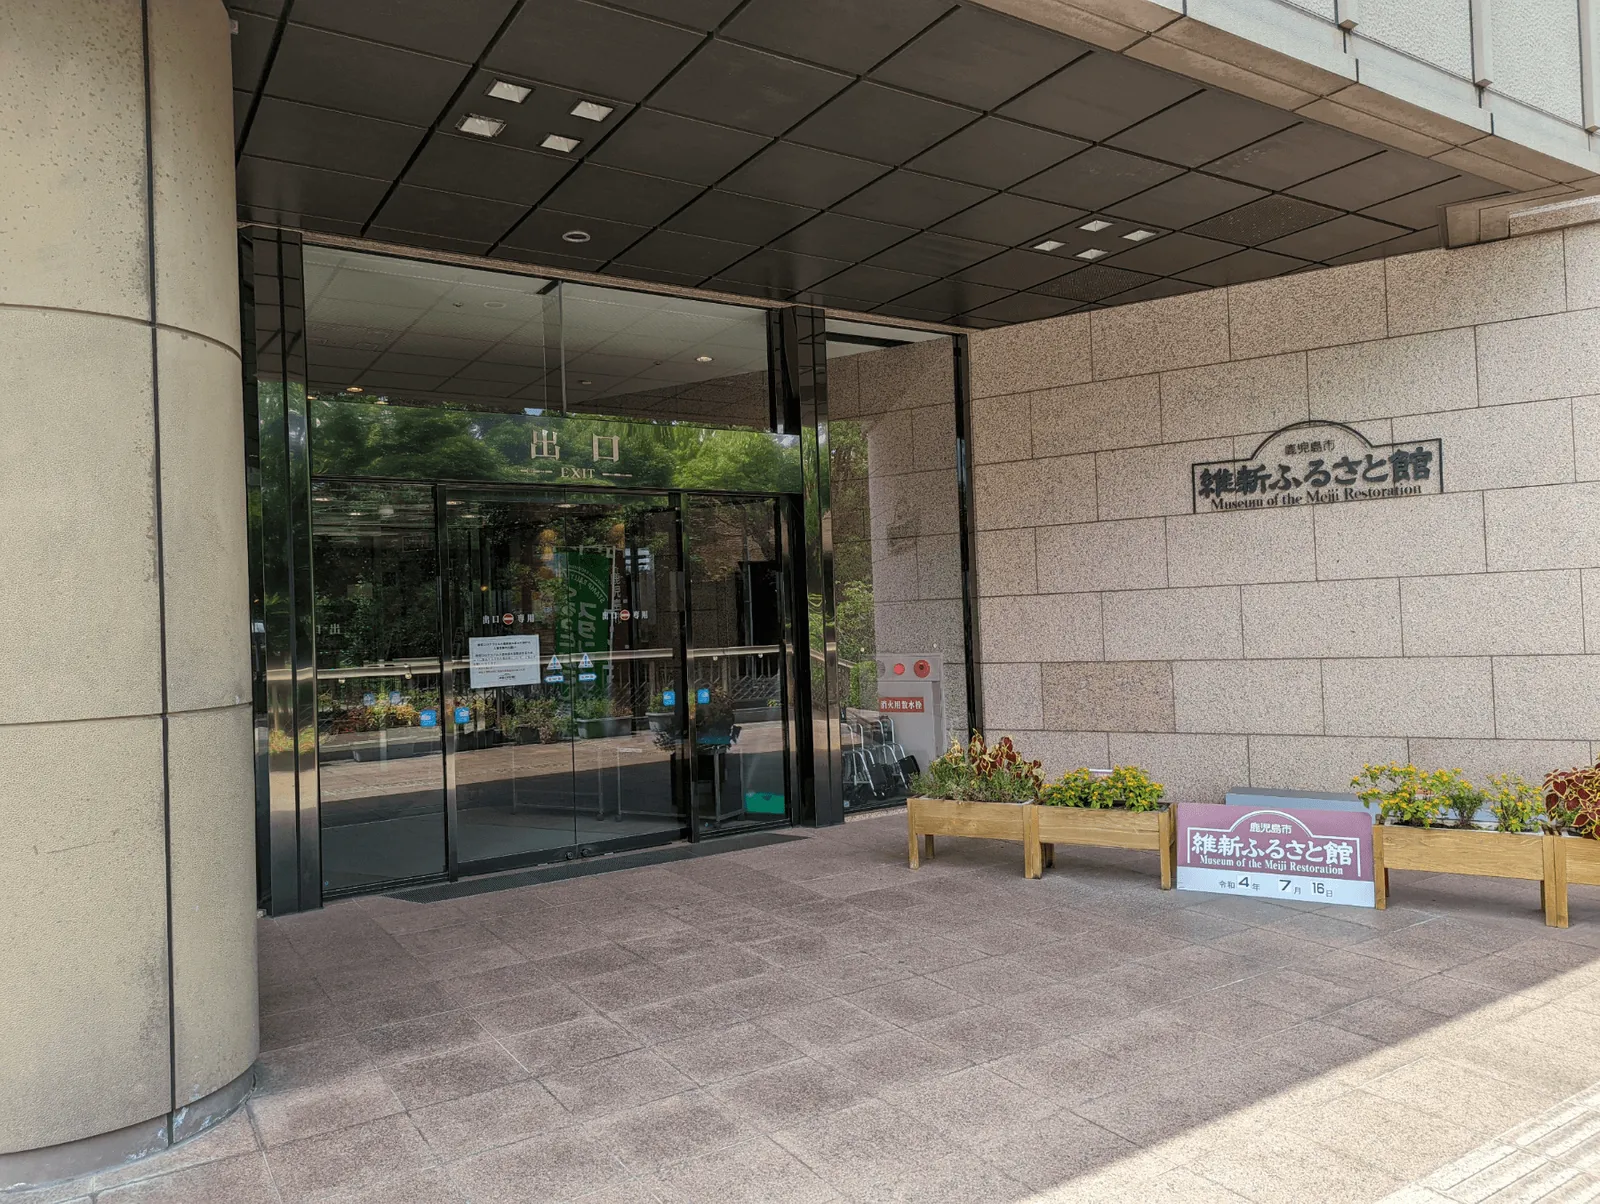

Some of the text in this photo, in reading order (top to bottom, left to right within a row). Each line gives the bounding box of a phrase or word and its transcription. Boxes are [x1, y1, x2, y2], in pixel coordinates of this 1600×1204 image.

[531, 429, 620, 463] 出口
[1285, 440, 1335, 456] 鹿児島市
[561, 467, 596, 479] EXIT
[1199, 447, 1433, 498] 維新ふるさと館
[1211, 484, 1422, 510] Museum of the Meiji Restoration
[881, 700, 923, 710] 消火用散水栓
[1249, 822, 1292, 835] 鹿児島市
[1191, 832, 1354, 866] 維新ふるさと館
[1200, 854, 1343, 875] Museum of the Meiji Restoration
